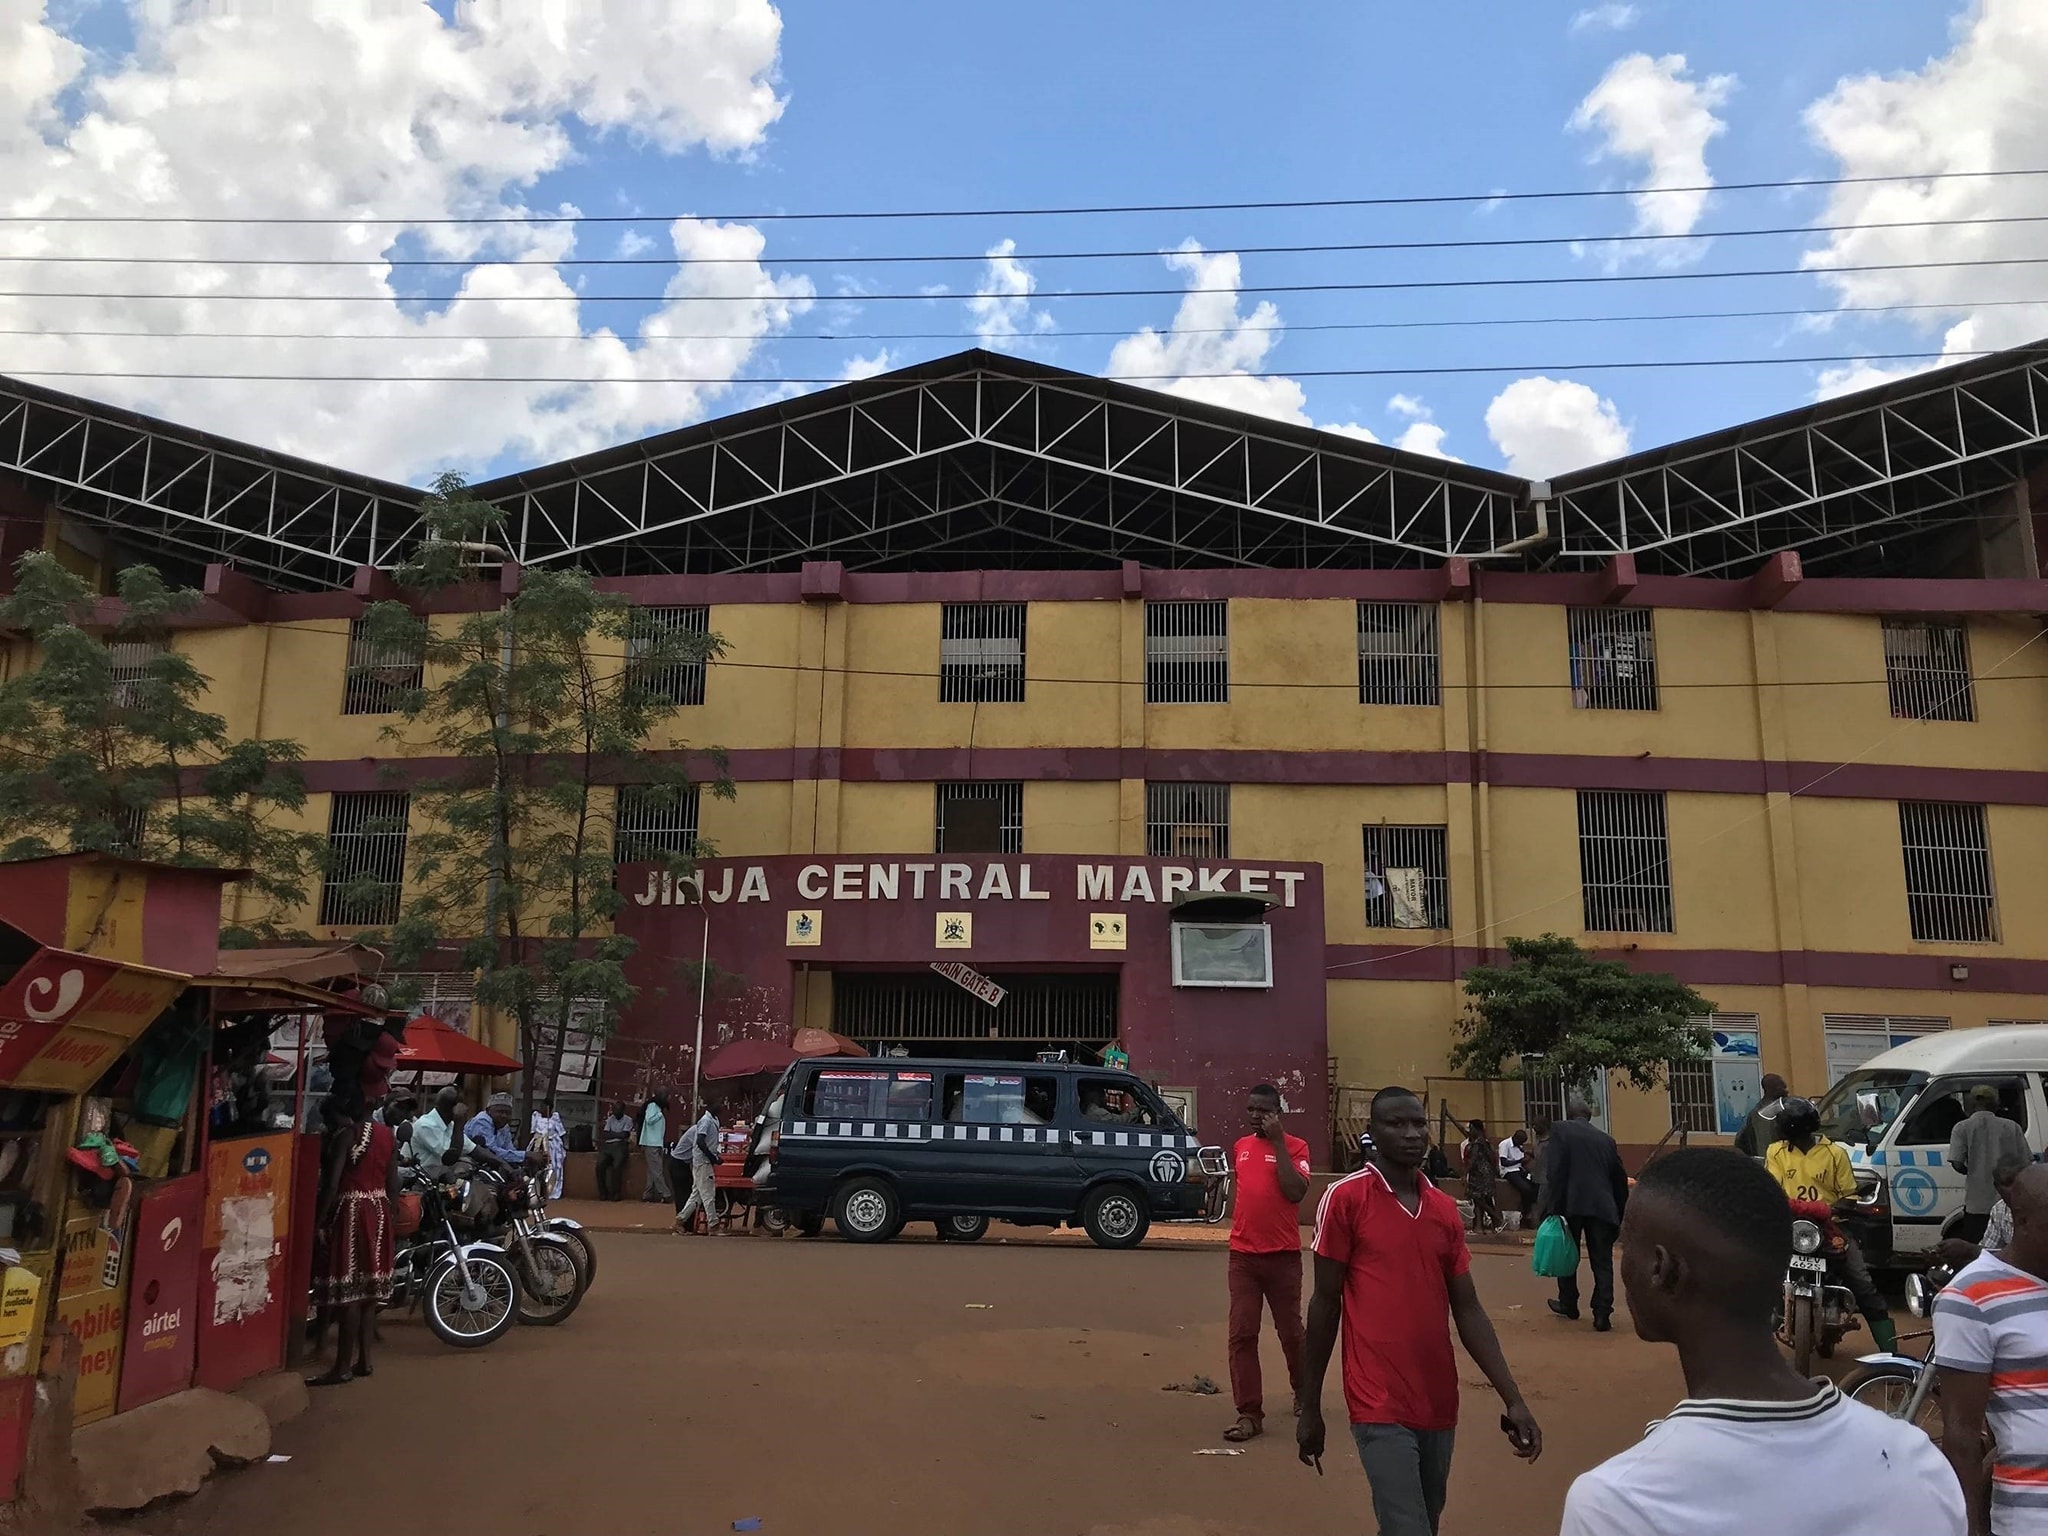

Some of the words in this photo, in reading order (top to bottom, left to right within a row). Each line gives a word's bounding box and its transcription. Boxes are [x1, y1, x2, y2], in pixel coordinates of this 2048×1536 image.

[796, 863, 1050, 901] CENTRAL
[1077, 864, 1305, 908] MARKET
[988, 986, 1000, 1002] B
[42, 1037, 109, 1068] Money
[1797, 1185, 1818, 1202] 20
[65, 1228, 97, 1253] MTN
[6, 1288, 29, 1297] Airtime
[4, 1296, 33, 1308] available
[142, 1308, 181, 1337] airtel
[144, 1335, 178, 1353] money
